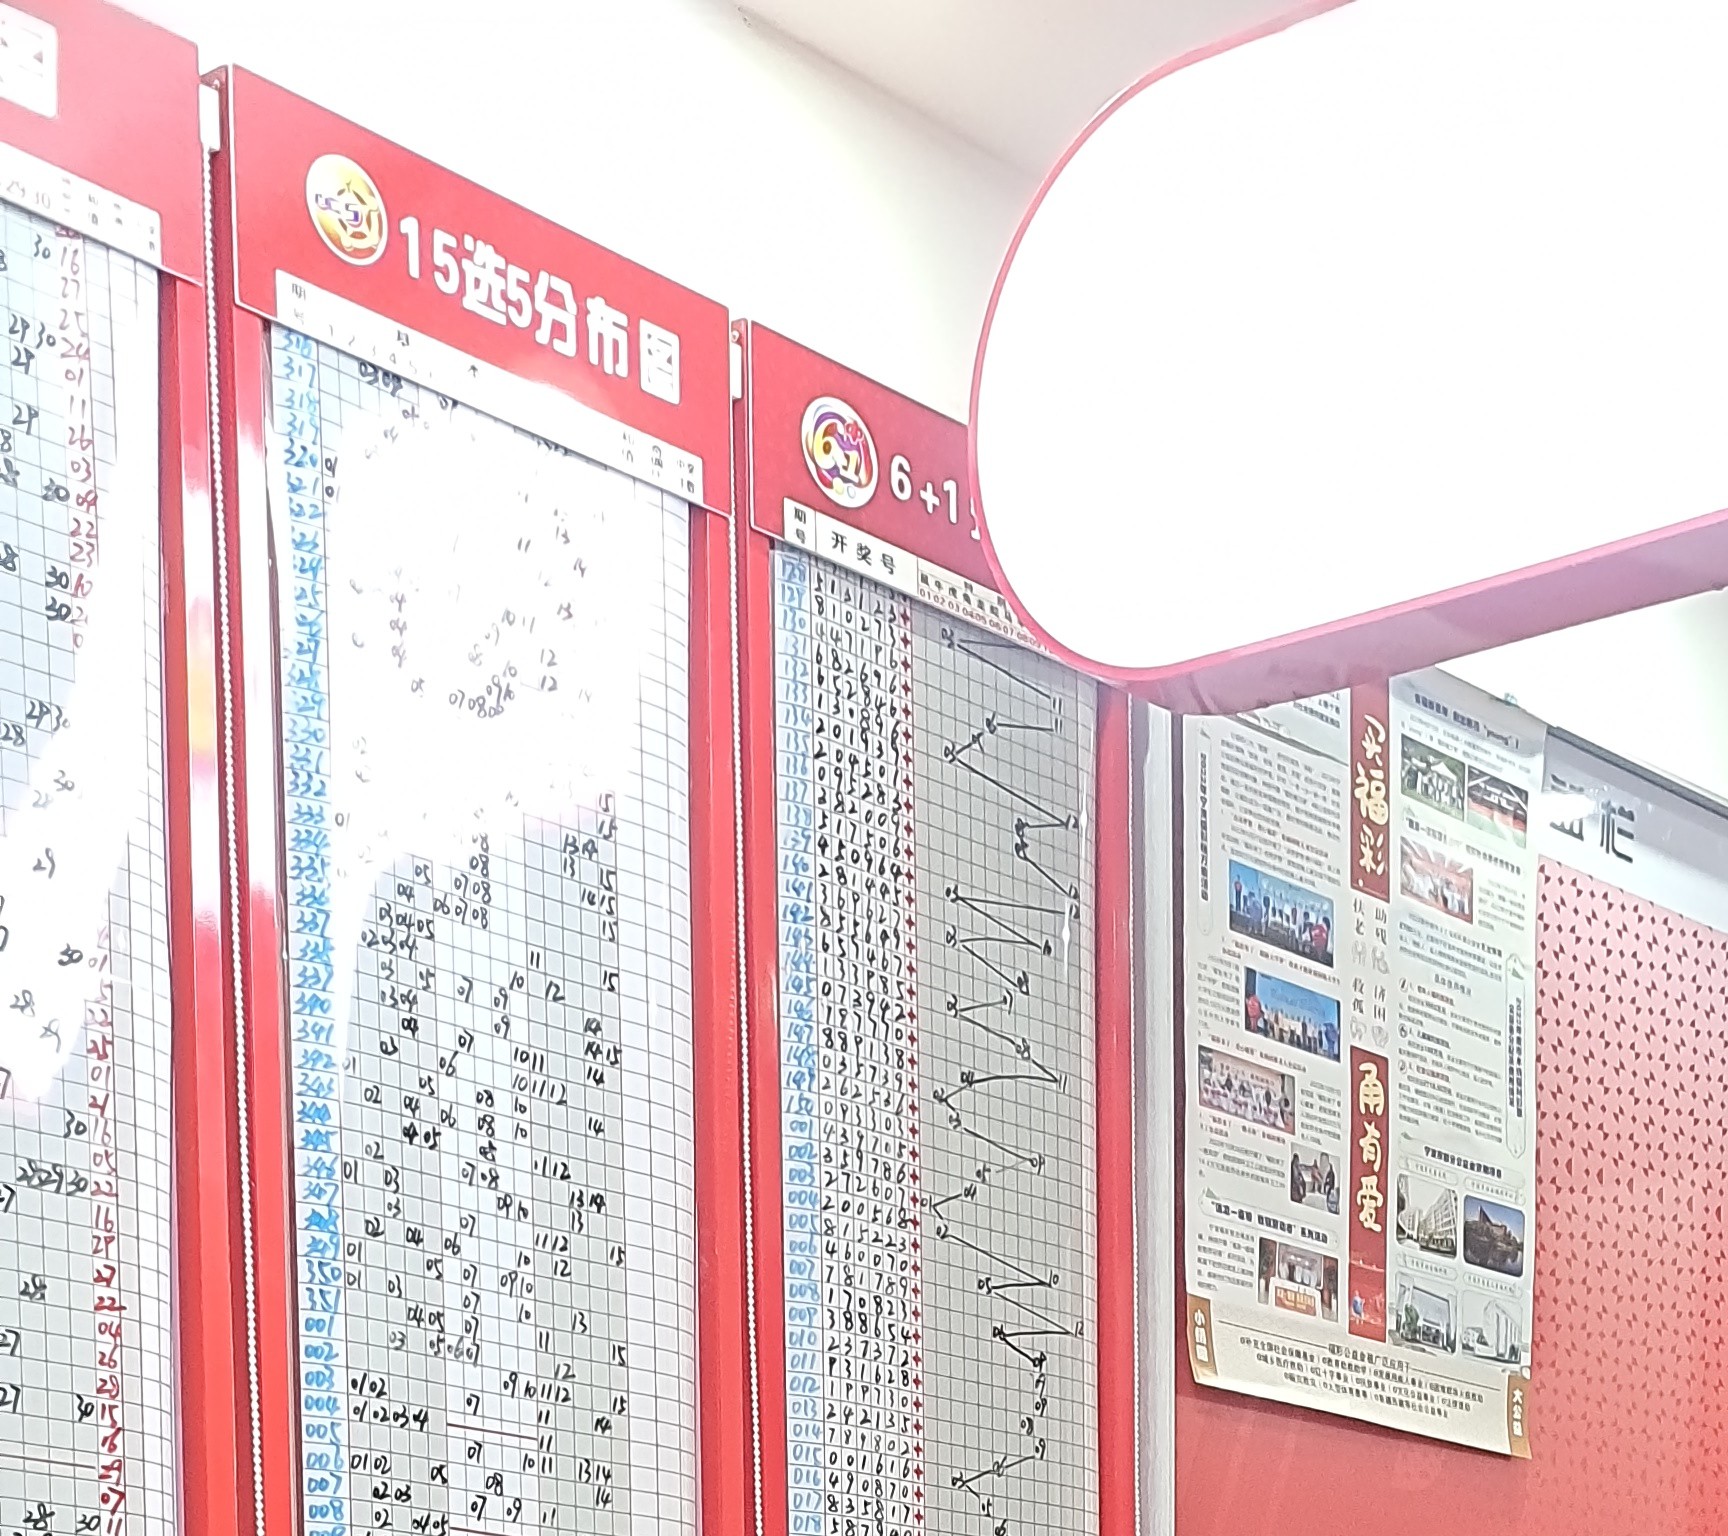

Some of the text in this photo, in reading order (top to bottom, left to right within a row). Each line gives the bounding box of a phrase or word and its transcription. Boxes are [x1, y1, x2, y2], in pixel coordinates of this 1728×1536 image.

[399, 215, 681, 405] 15选5分布图
[890, 454, 981, 541] 6+1
